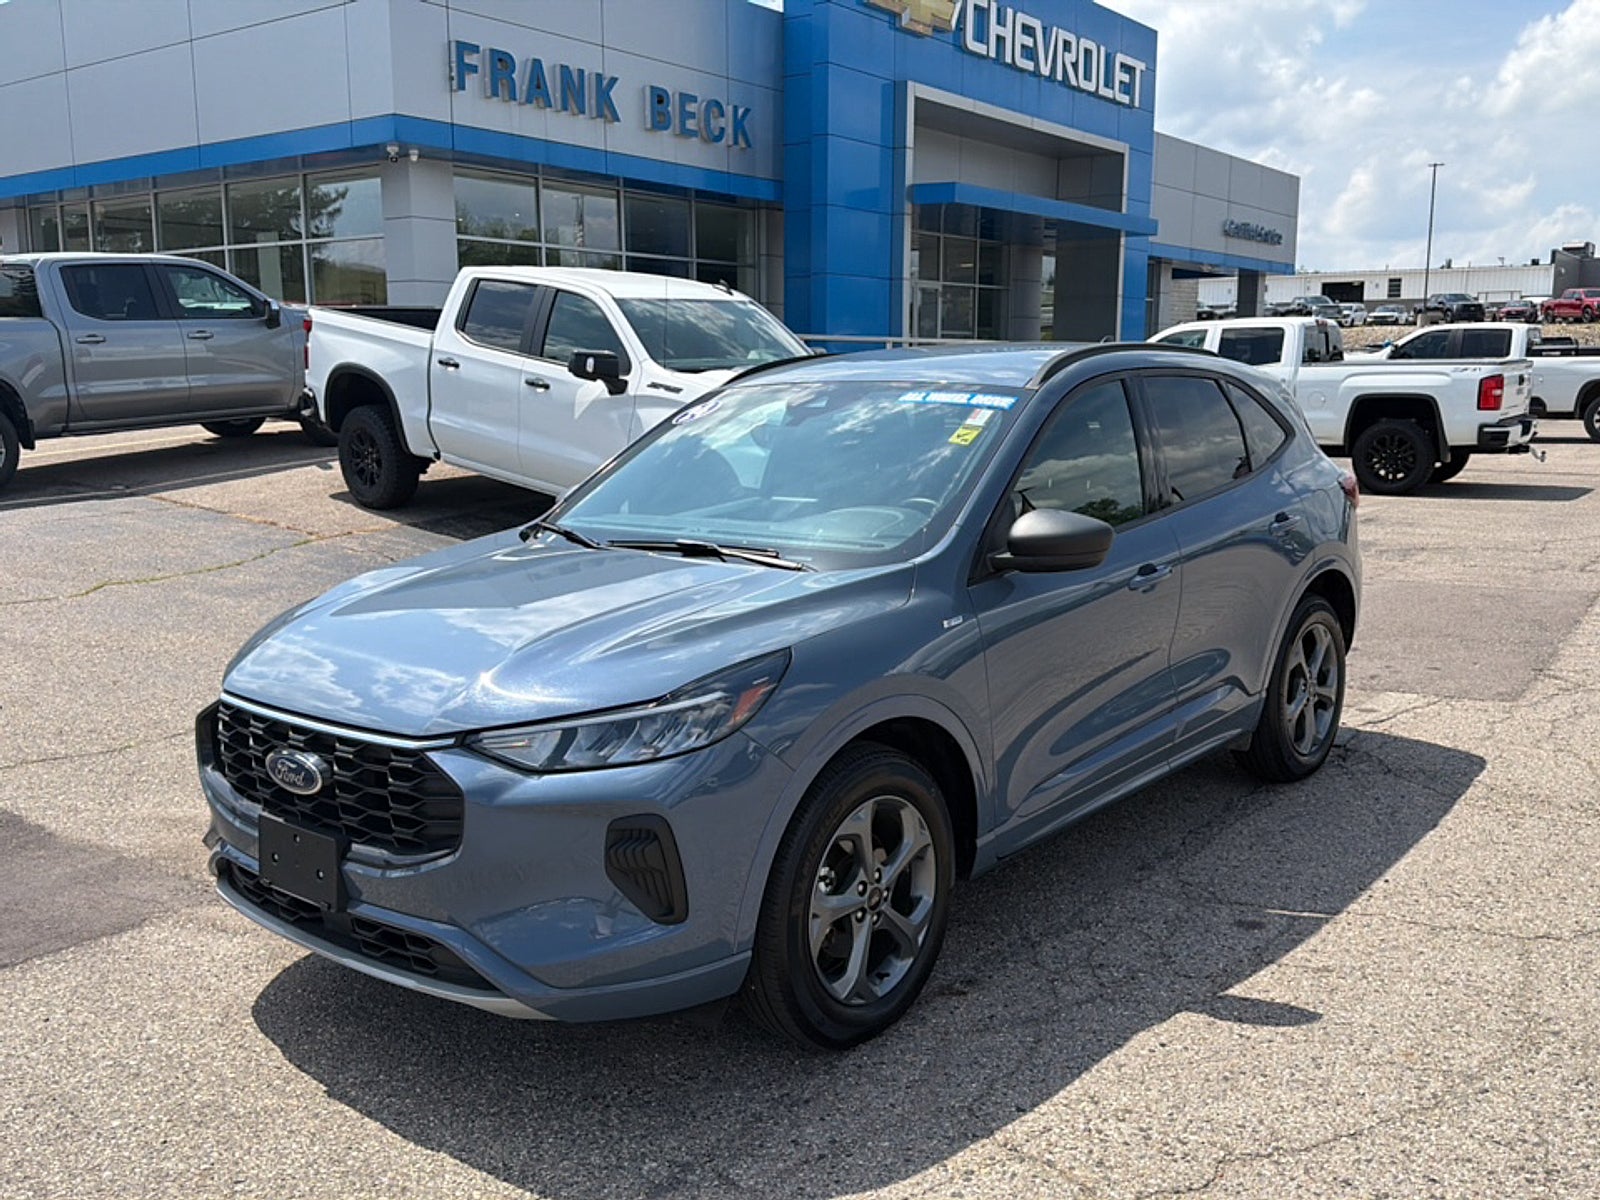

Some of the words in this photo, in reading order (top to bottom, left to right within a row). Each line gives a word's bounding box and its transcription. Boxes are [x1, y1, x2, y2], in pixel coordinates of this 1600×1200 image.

[449, 40, 621, 123] FRANK
[643, 84, 753, 149] BECK
[963, 0, 1146, 108] CHEVROLET
[275, 758, 305, 787] Ford
